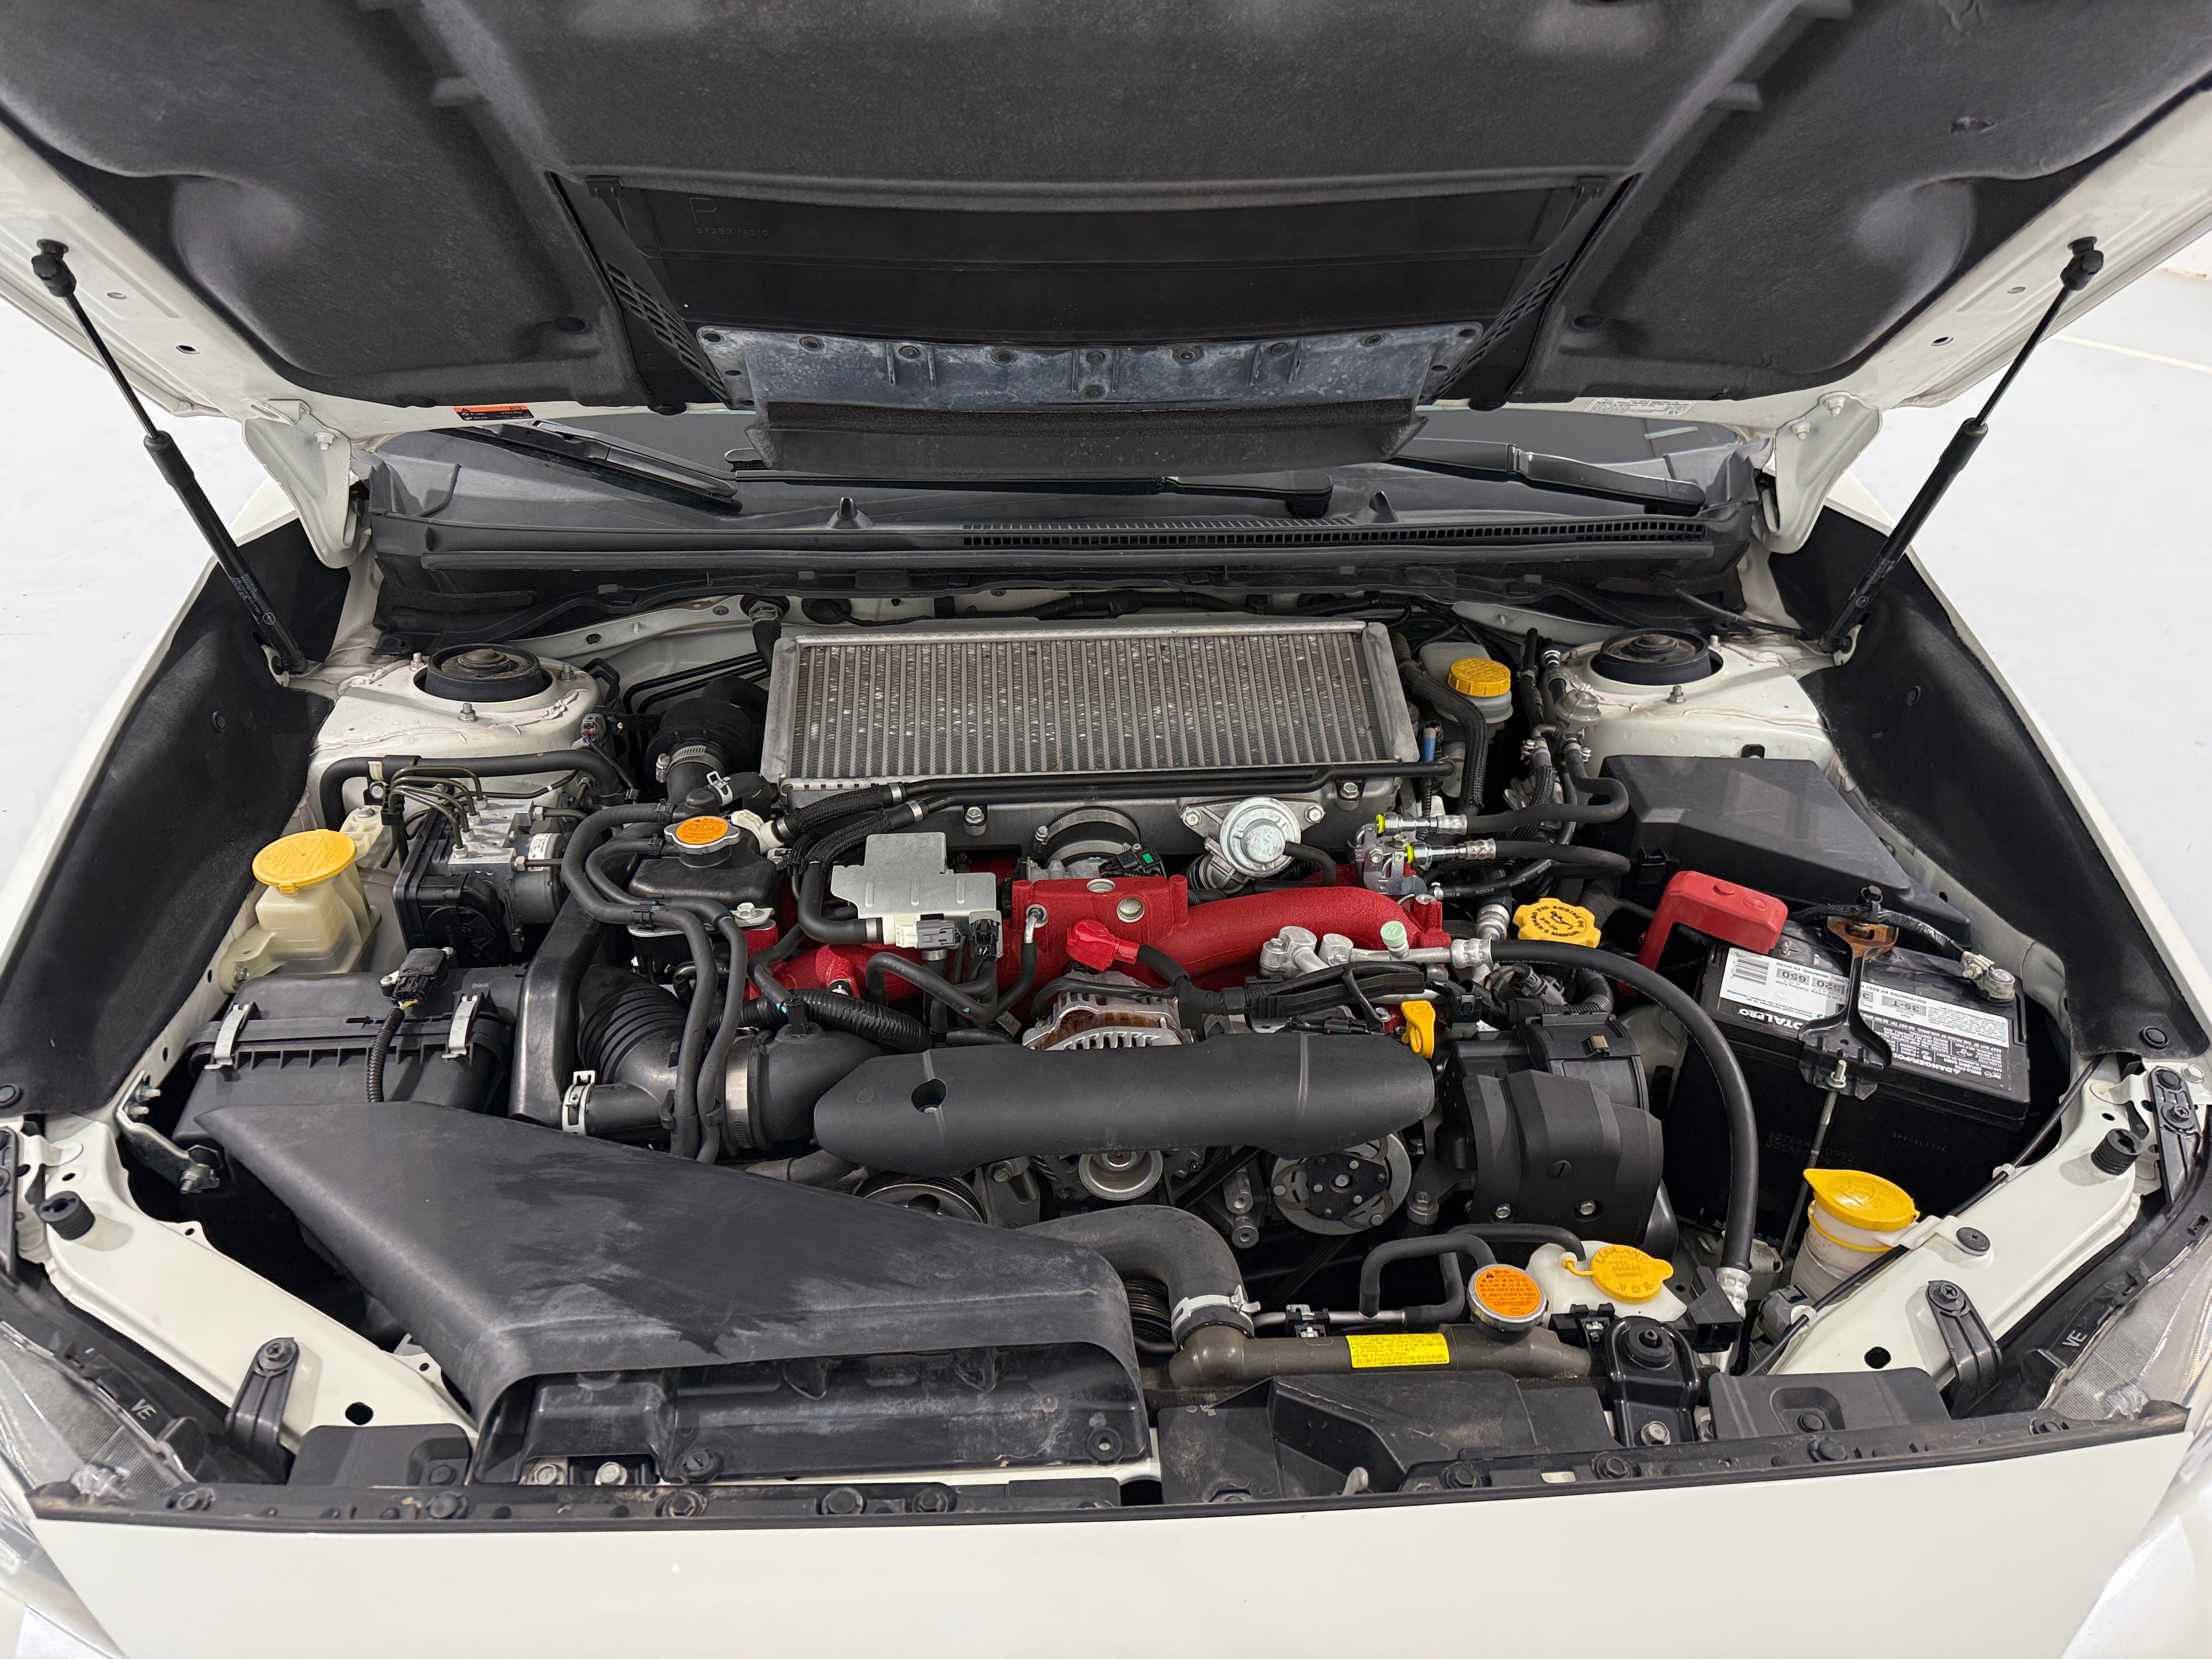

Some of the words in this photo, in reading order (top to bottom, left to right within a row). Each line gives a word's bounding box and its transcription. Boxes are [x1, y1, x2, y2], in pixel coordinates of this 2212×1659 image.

[1553, 906, 1581, 919] ENGINE
[1781, 970, 1806, 983] 650
[1816, 980, 1841, 991] 520
[1890, 991, 1926, 1003] DISTRIBUTED
[1890, 1000, 1920, 1012] 35-T
[1595, 1247, 1650, 1263] COOLANT
